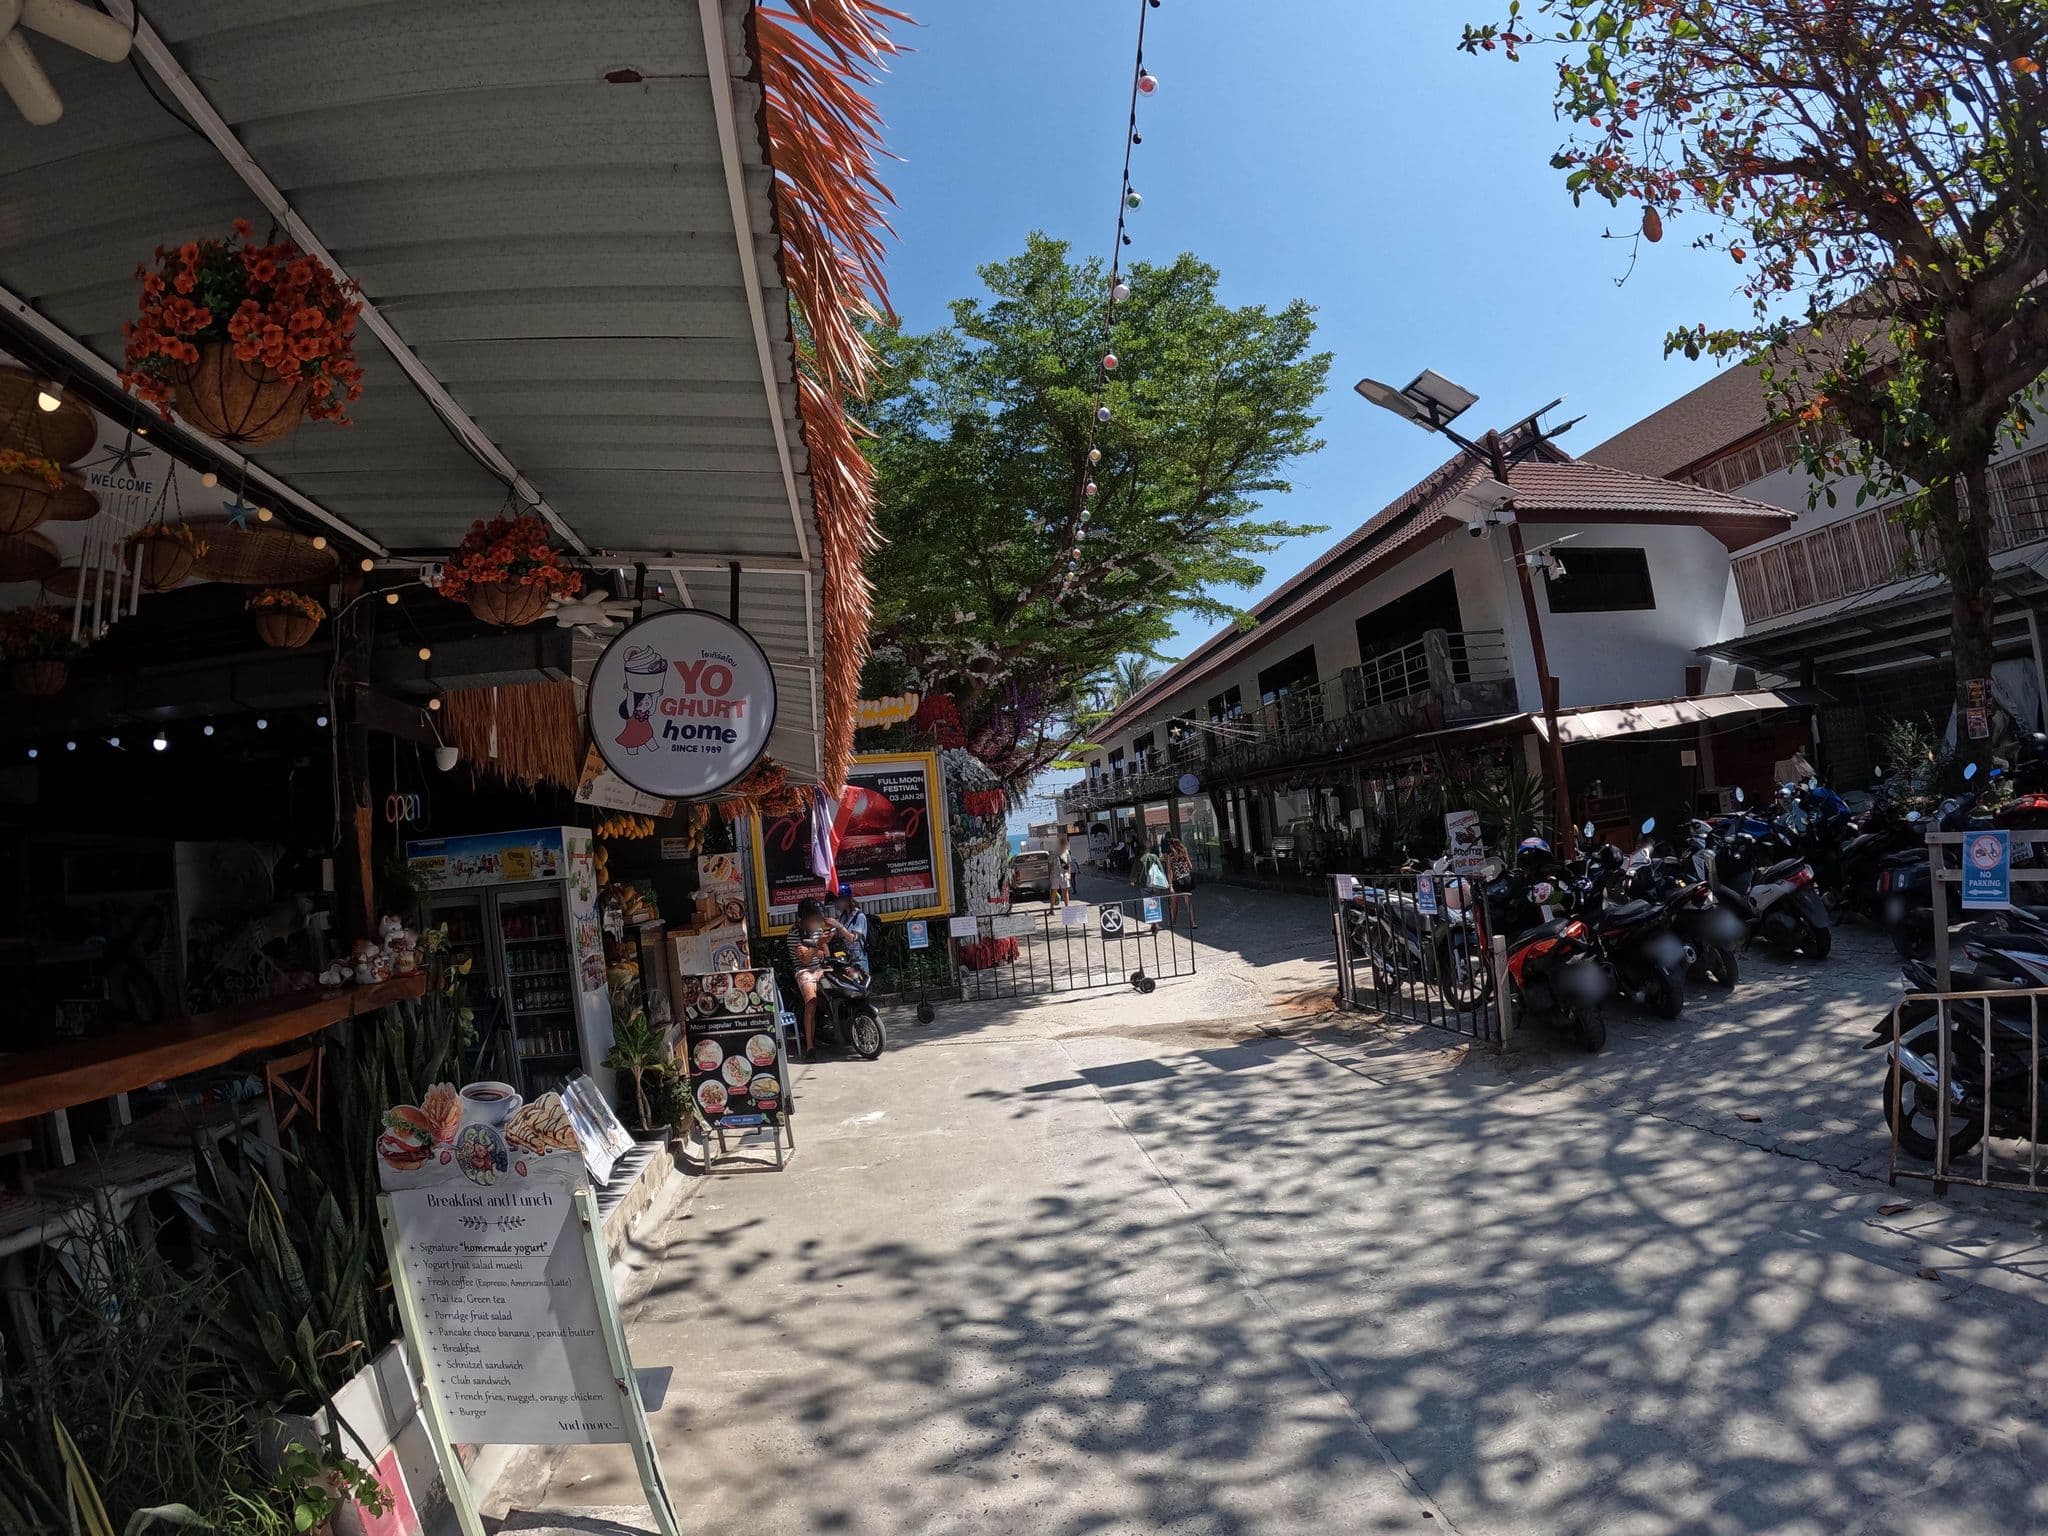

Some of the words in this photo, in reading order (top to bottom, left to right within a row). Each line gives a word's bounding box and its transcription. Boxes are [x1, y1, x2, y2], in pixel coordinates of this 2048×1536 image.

[90, 472, 152, 494] WELCOME
[673, 659, 733, 697] YO
[659, 697, 747, 718] GHURT
[662, 720, 737, 744] home
[671, 744, 698, 753] SINCE
[701, 745, 722, 754] 1989
[386, 795, 420, 828] open
[708, 1022, 732, 1030] popular
[427, 1192, 483, 1207] Breakfast
[487, 1192, 510, 1207] and
[512, 1192, 553, 1206] Lunch
[419, 1242, 459, 1254] Signature
[423, 1260, 451, 1272] Yogurt
[451, 1260, 470, 1272] fruit
[472, 1260, 493, 1270] salad
[495, 1261, 524, 1270] muesli
[427, 1276, 450, 1286] Fresh
[451, 1276, 474, 1290] coffee
[430, 1294, 450, 1304] Thai
[450, 1296, 466, 1304] tea,
[467, 1294, 490, 1304] Green
[492, 1296, 506, 1304] tea
[434, 1310, 470, 1323] Porridge
[470, 1310, 489, 1323] fruit
[490, 1310, 513, 1320] salad
[438, 1328, 472, 1337] Pancake
[474, 1328, 496, 1337] choco
[498, 1328, 530, 1337] banana
[536, 1328, 567, 1339] peanut
[568, 1328, 595, 1337] butter
[442, 1344, 481, 1354] Breakfast
[446, 1361, 484, 1370] Schnitzel
[485, 1361, 524, 1370] sandwich
[450, 1376, 471, 1385] Club
[472, 1376, 512, 1386] sandwich
[454, 1392, 484, 1402] French
[484, 1392, 506, 1403] fries,
[506, 1394, 538, 1404] nugget,
[540, 1394, 568, 1404] orange
[570, 1392, 604, 1401] chicken
[459, 1408, 488, 1419] Burger
[558, 1420, 580, 1430] And
